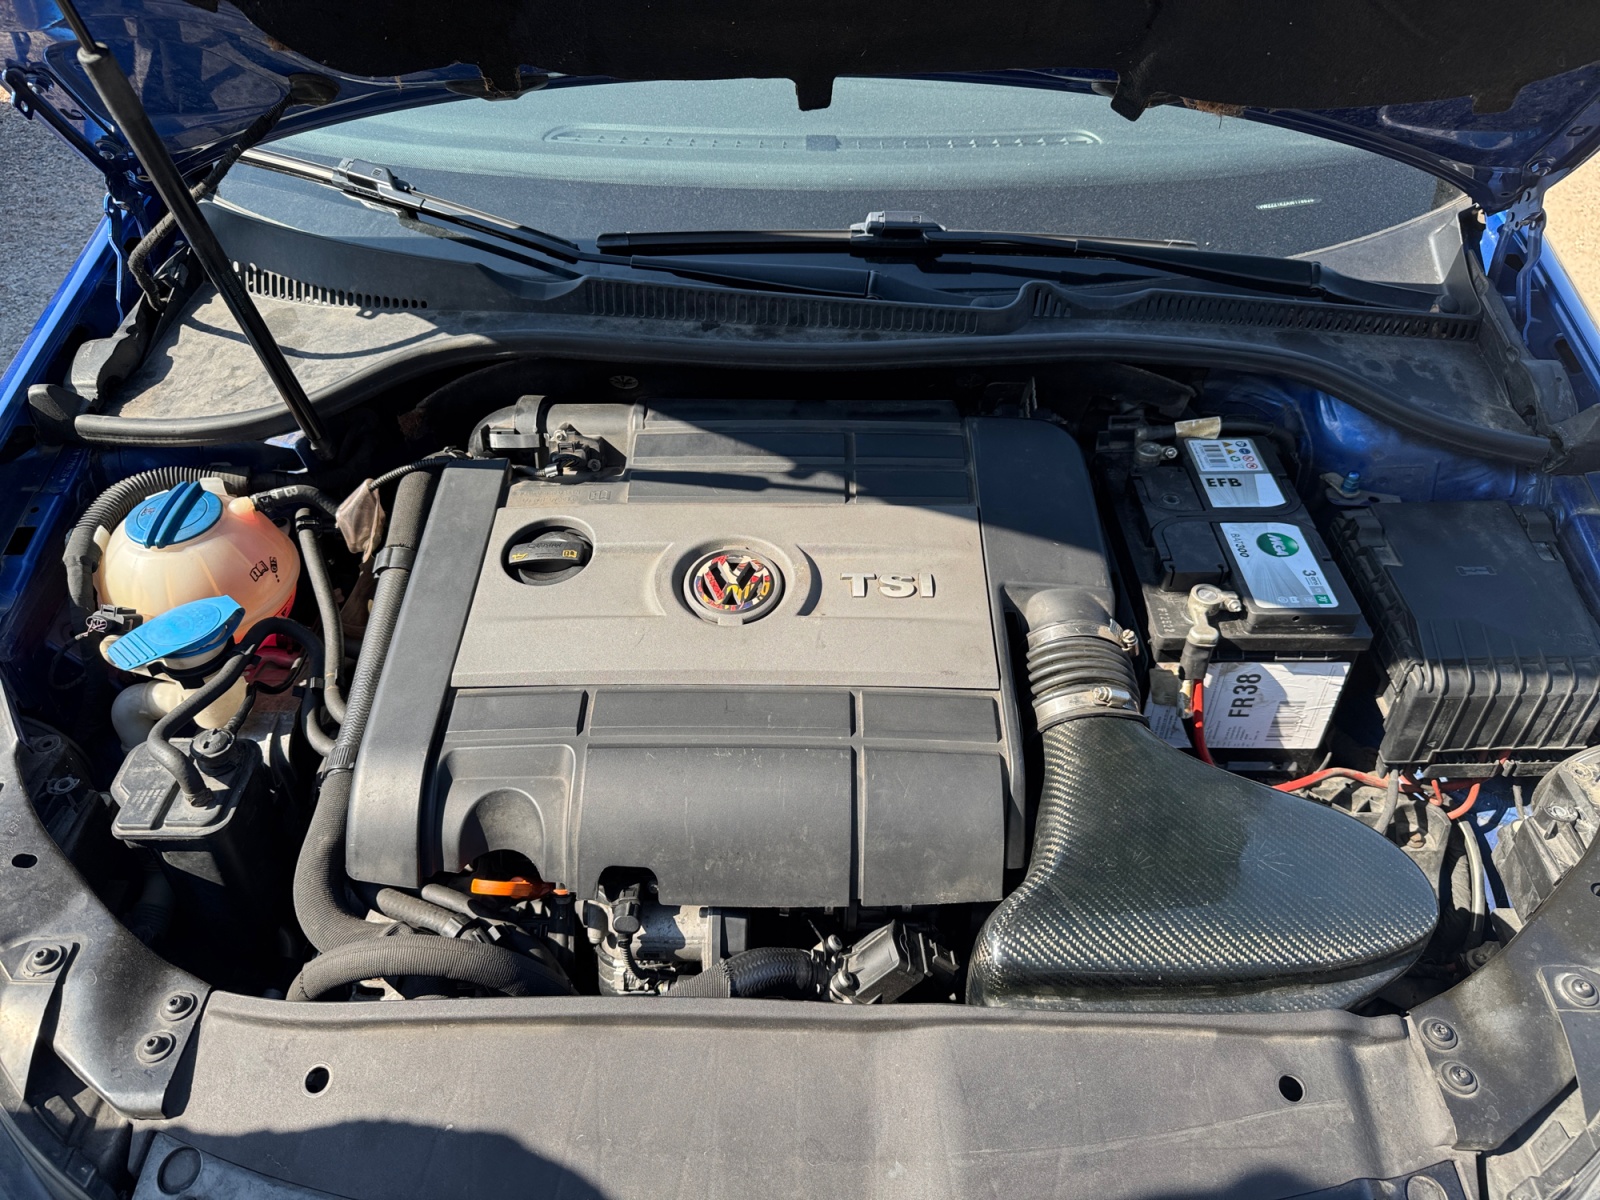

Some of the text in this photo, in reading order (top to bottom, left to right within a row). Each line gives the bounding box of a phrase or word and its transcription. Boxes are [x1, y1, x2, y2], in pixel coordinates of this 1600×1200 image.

[1205, 477, 1242, 488] EFB
[1230, 533, 1250, 558] BAT300
[841, 573, 936, 598] TSI
[1228, 673, 1262, 718] FR38
